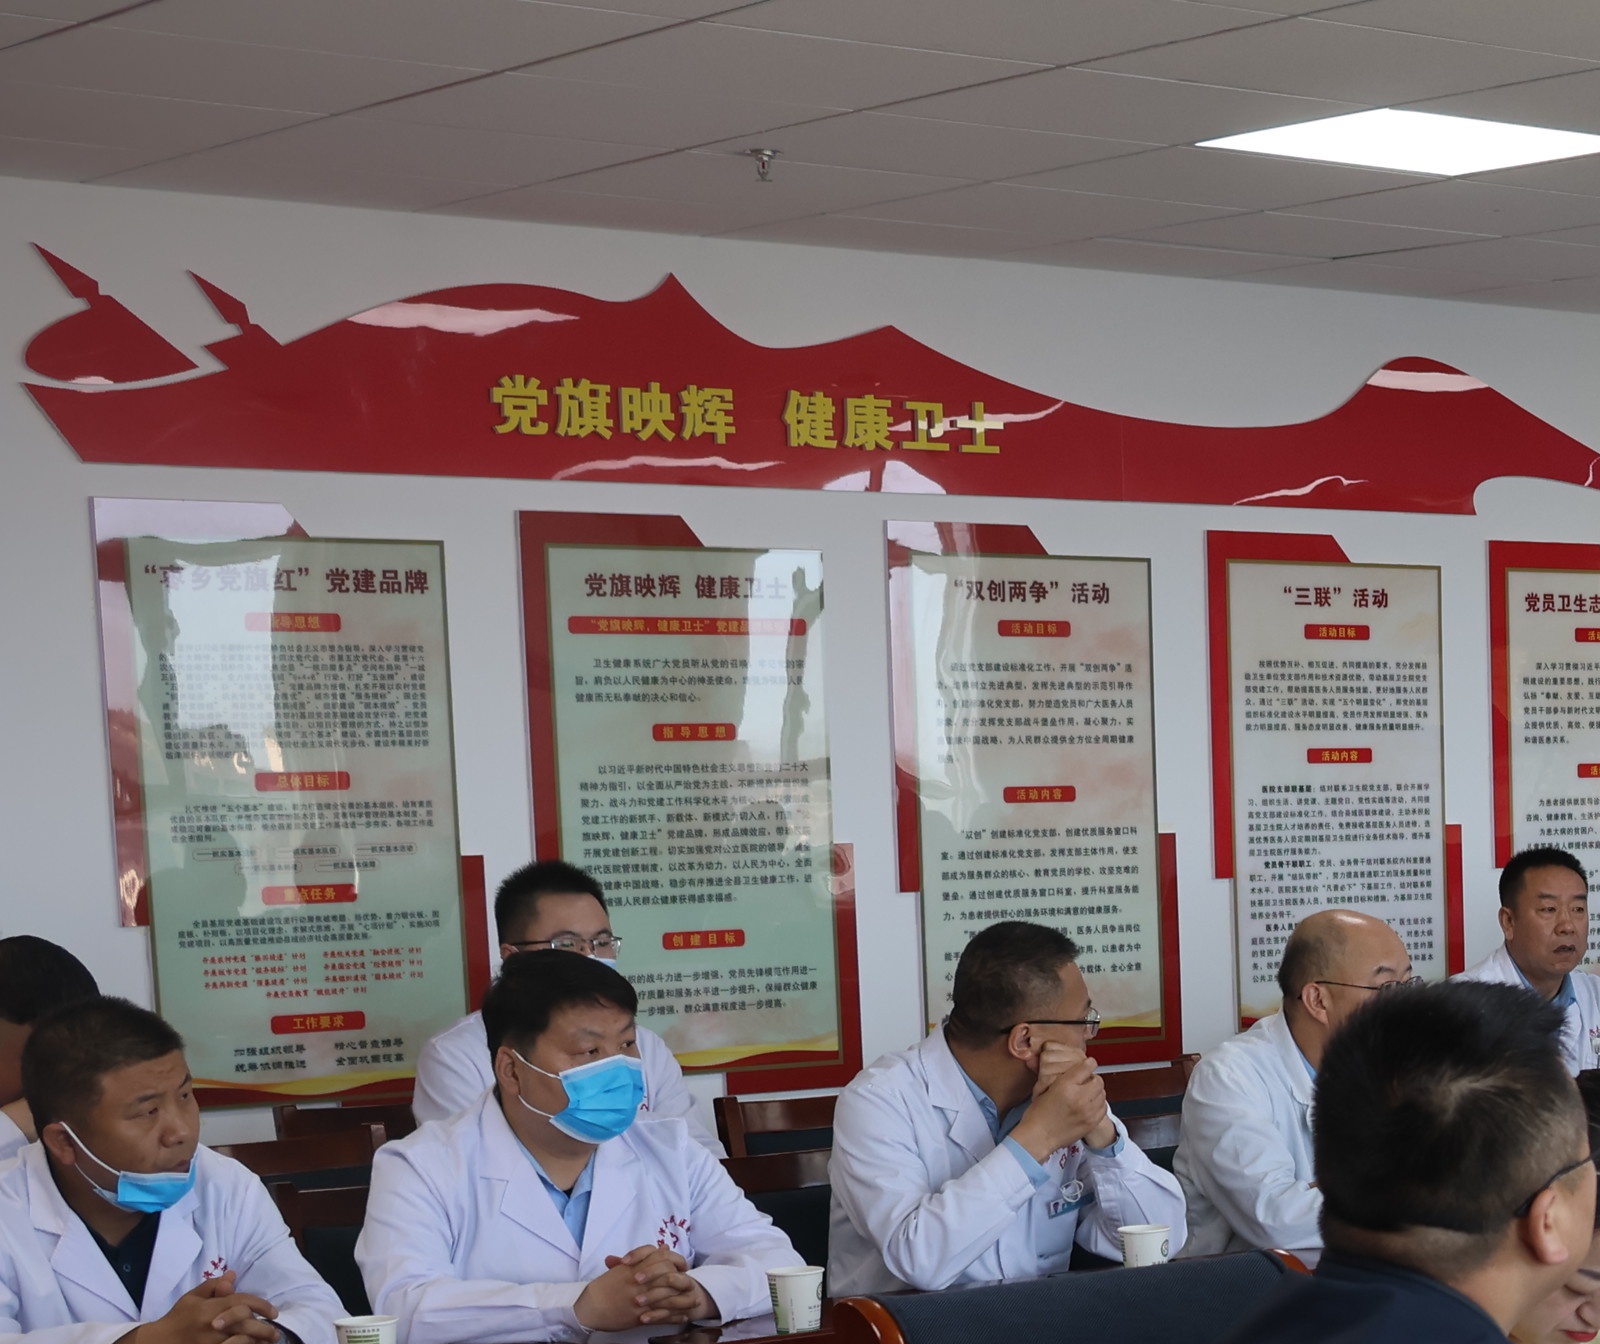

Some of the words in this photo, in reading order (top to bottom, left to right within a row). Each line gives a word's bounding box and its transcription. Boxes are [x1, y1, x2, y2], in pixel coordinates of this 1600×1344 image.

[490, 374, 736, 444] 党旗映辉
[783, 389, 1004, 454] 健康卫士
[584, 573, 681, 598] 党旗映辉
[695, 574, 787, 600] 健康卫士
[1284, 586, 1389, 609] “三联”活动
[1011, 623, 1058, 635] 活动目标
[1318, 627, 1357, 638] 活动目标
[662, 726, 727, 739] 指导思想
[1321, 750, 1358, 762] 活动内容
[1016, 789, 1063, 800] 活动内容
[601, 875, 812, 890] 健康中国战略，稳步有序推进全县卫生健康工作，进
[672, 933, 736, 946] 创建目标
[624, 967, 817, 984] 织的战斗力进一步增强，党员先锋模范作用进一
[292, 1016, 345, 1029] 工作要求
